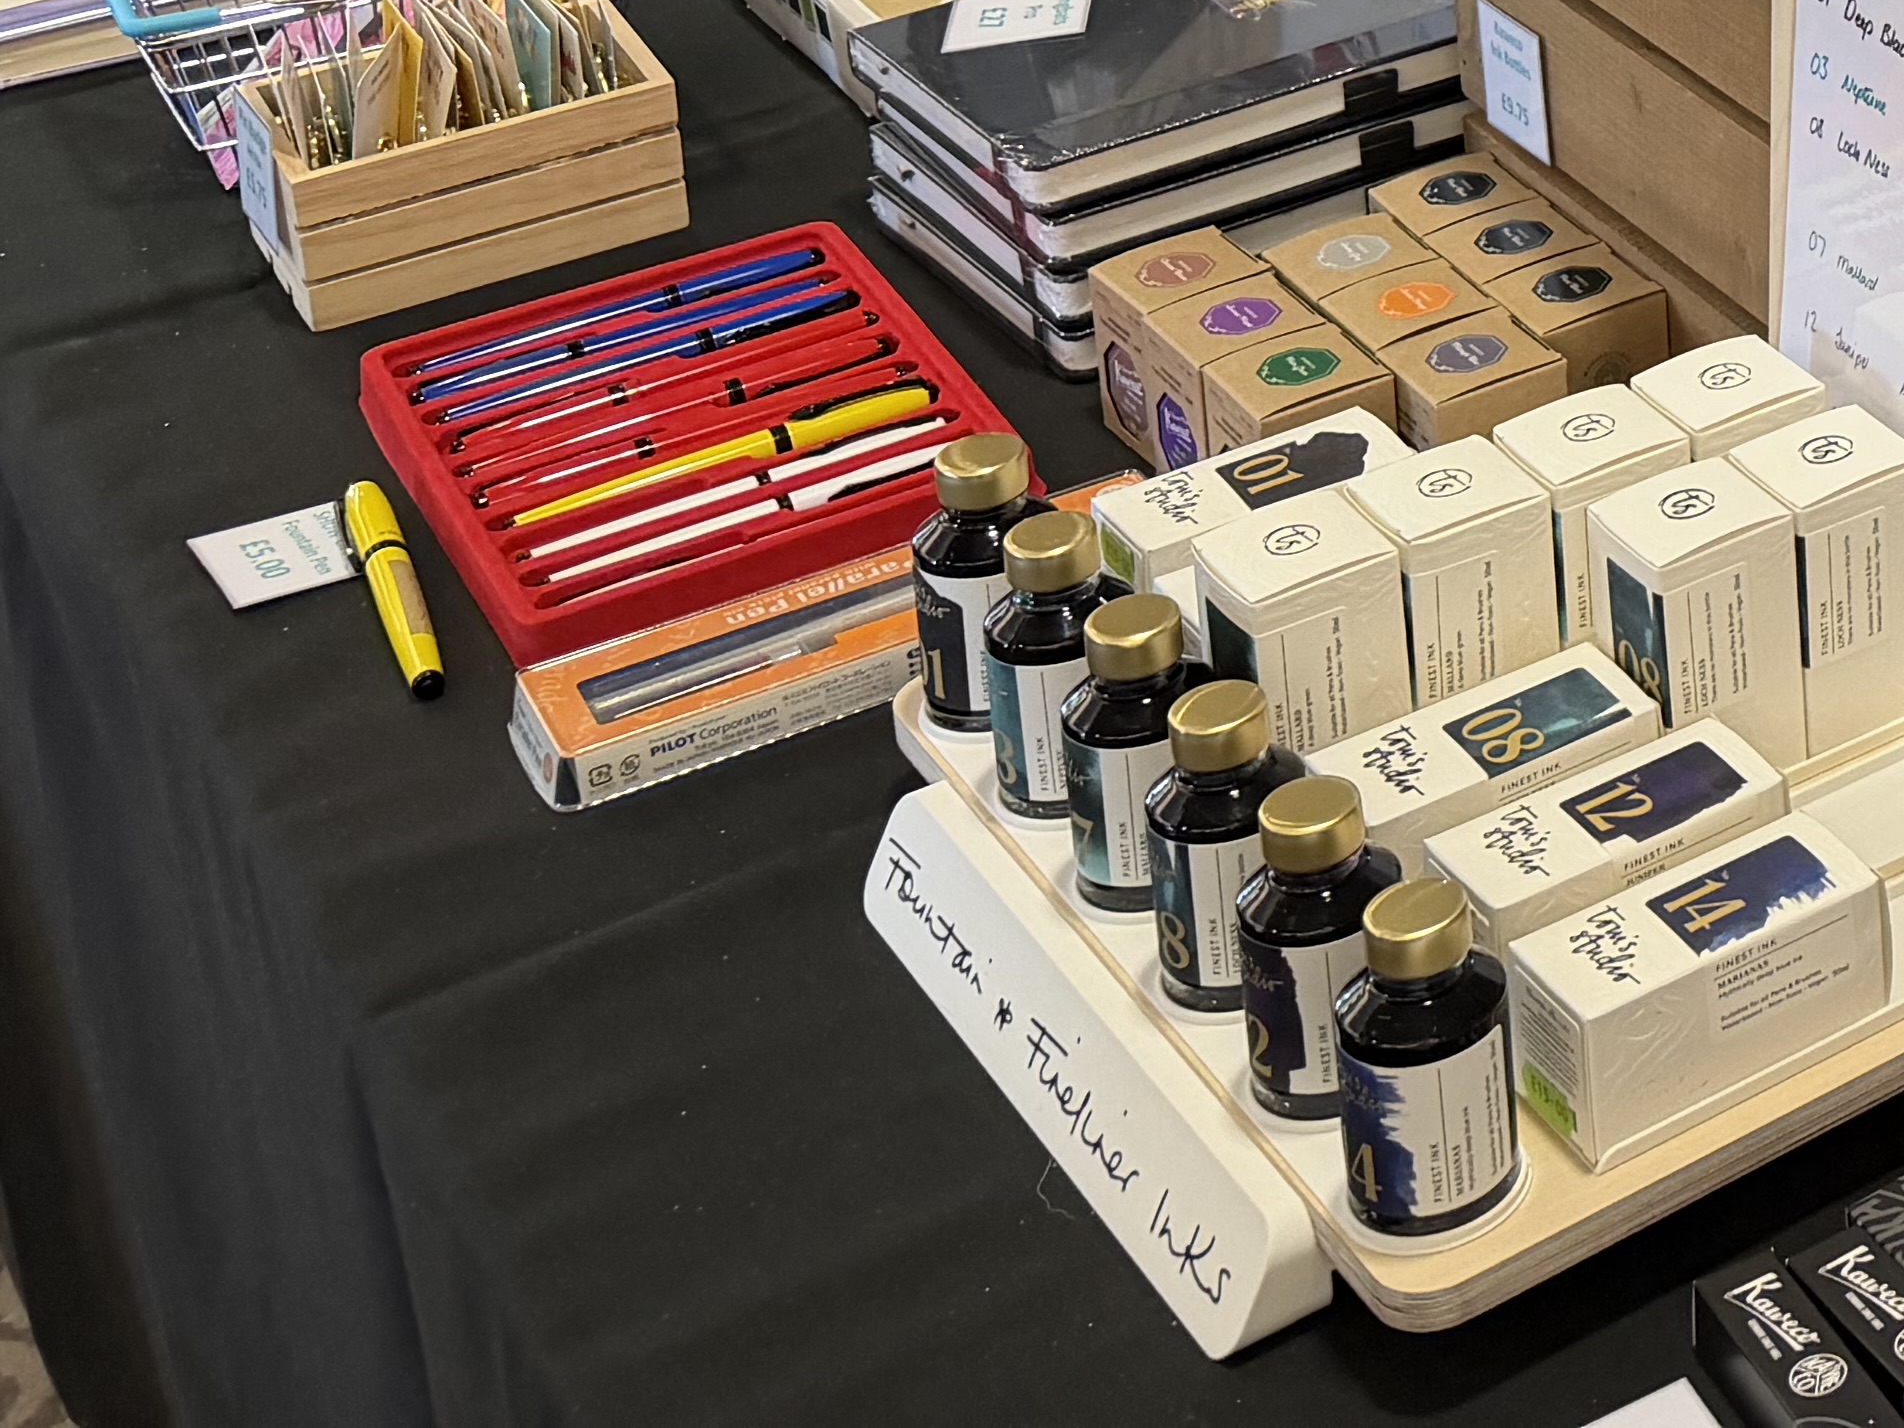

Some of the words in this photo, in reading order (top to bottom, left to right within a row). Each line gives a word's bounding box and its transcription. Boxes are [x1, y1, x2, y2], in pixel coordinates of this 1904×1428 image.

[1230, 452, 1308, 496] 01
[238, 538, 291, 580] £5.00
[281, 518, 320, 562] Fountain
[313, 555, 332, 575] Pen
[649, 733, 697, 758] PILOT
[699, 705, 778, 741] Corporation
[1459, 705, 1547, 765] 08
[1575, 778, 1654, 832] 12
[1663, 879, 1747, 936] 14
[886, 836, 993, 996] Fountain
[1024, 1017, 1141, 1194] Fineliner
